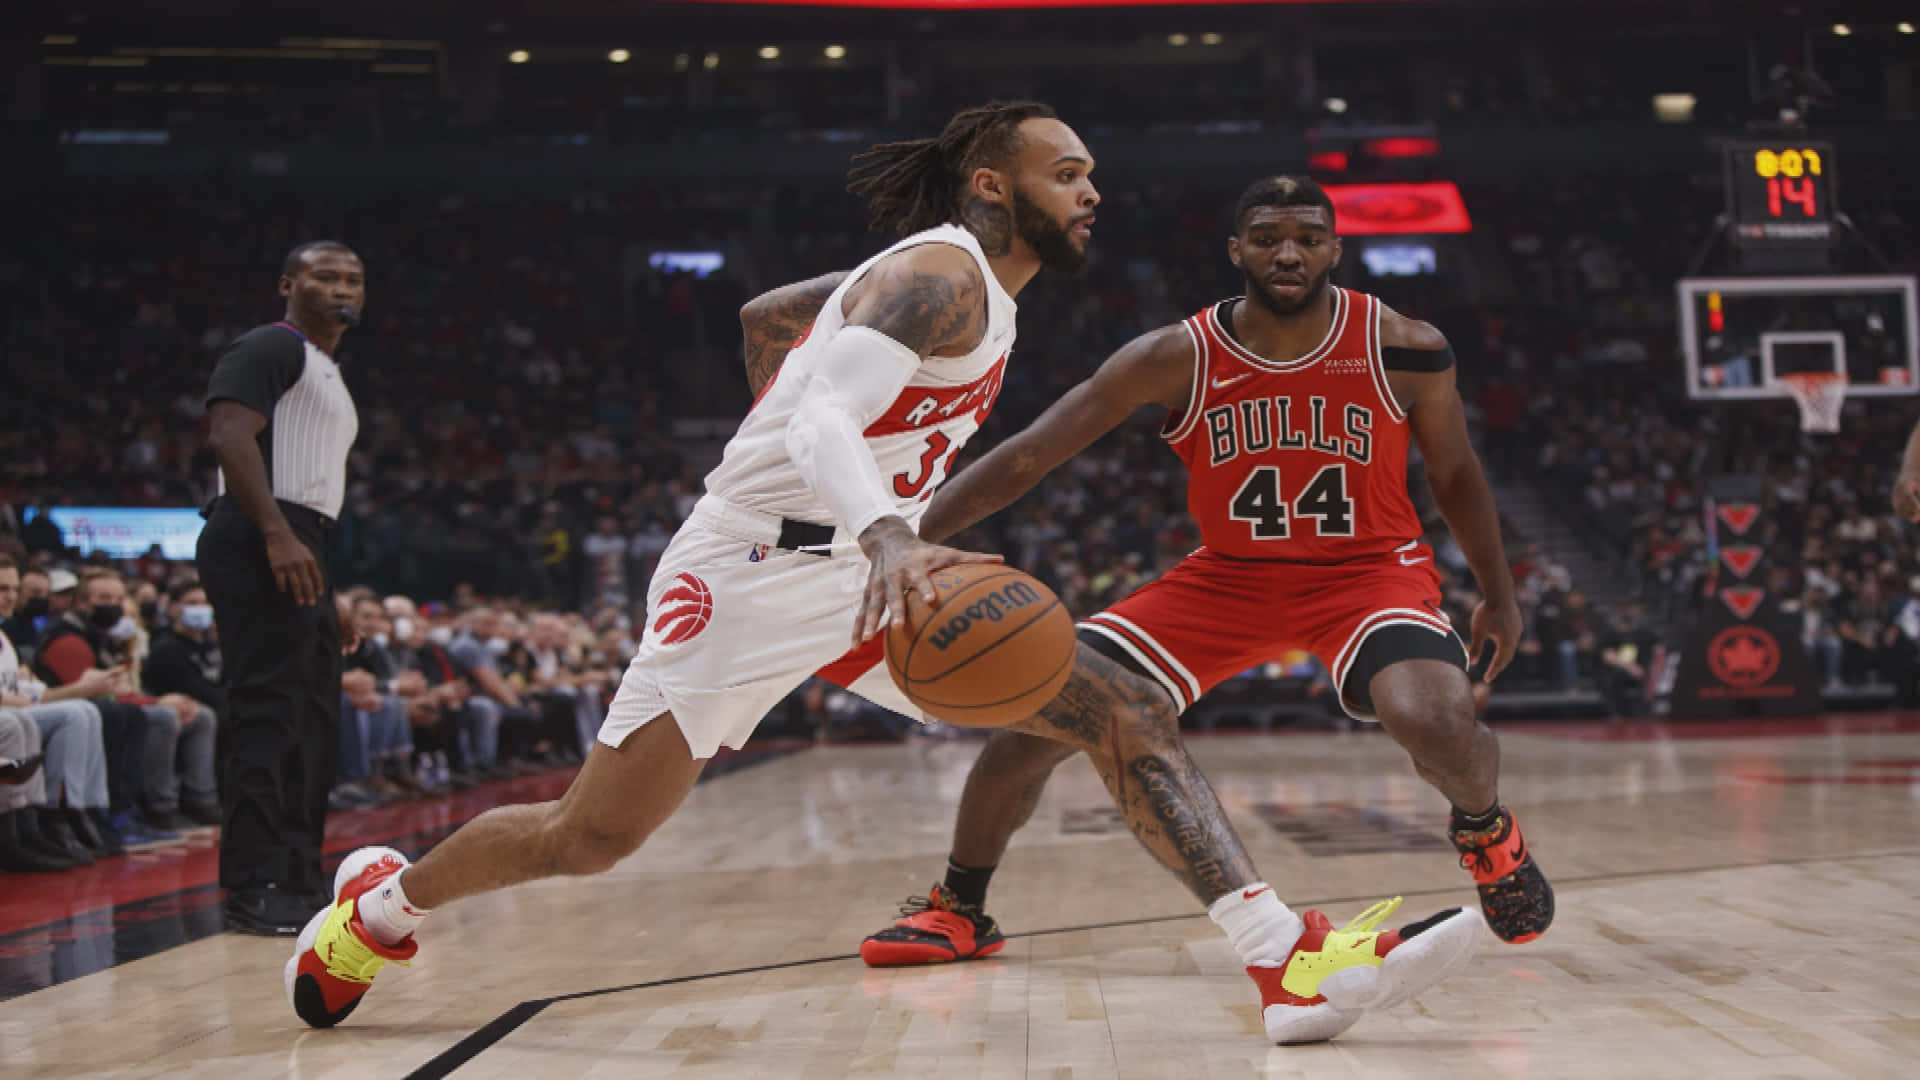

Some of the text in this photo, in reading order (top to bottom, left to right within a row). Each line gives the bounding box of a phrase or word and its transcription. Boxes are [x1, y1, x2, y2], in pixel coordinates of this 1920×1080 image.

[1767, 178, 1816, 217] 14
[1204, 395, 1372, 467] BULLS
[1229, 464, 1354, 540] 44
[928, 581, 1043, 651] Wilson
